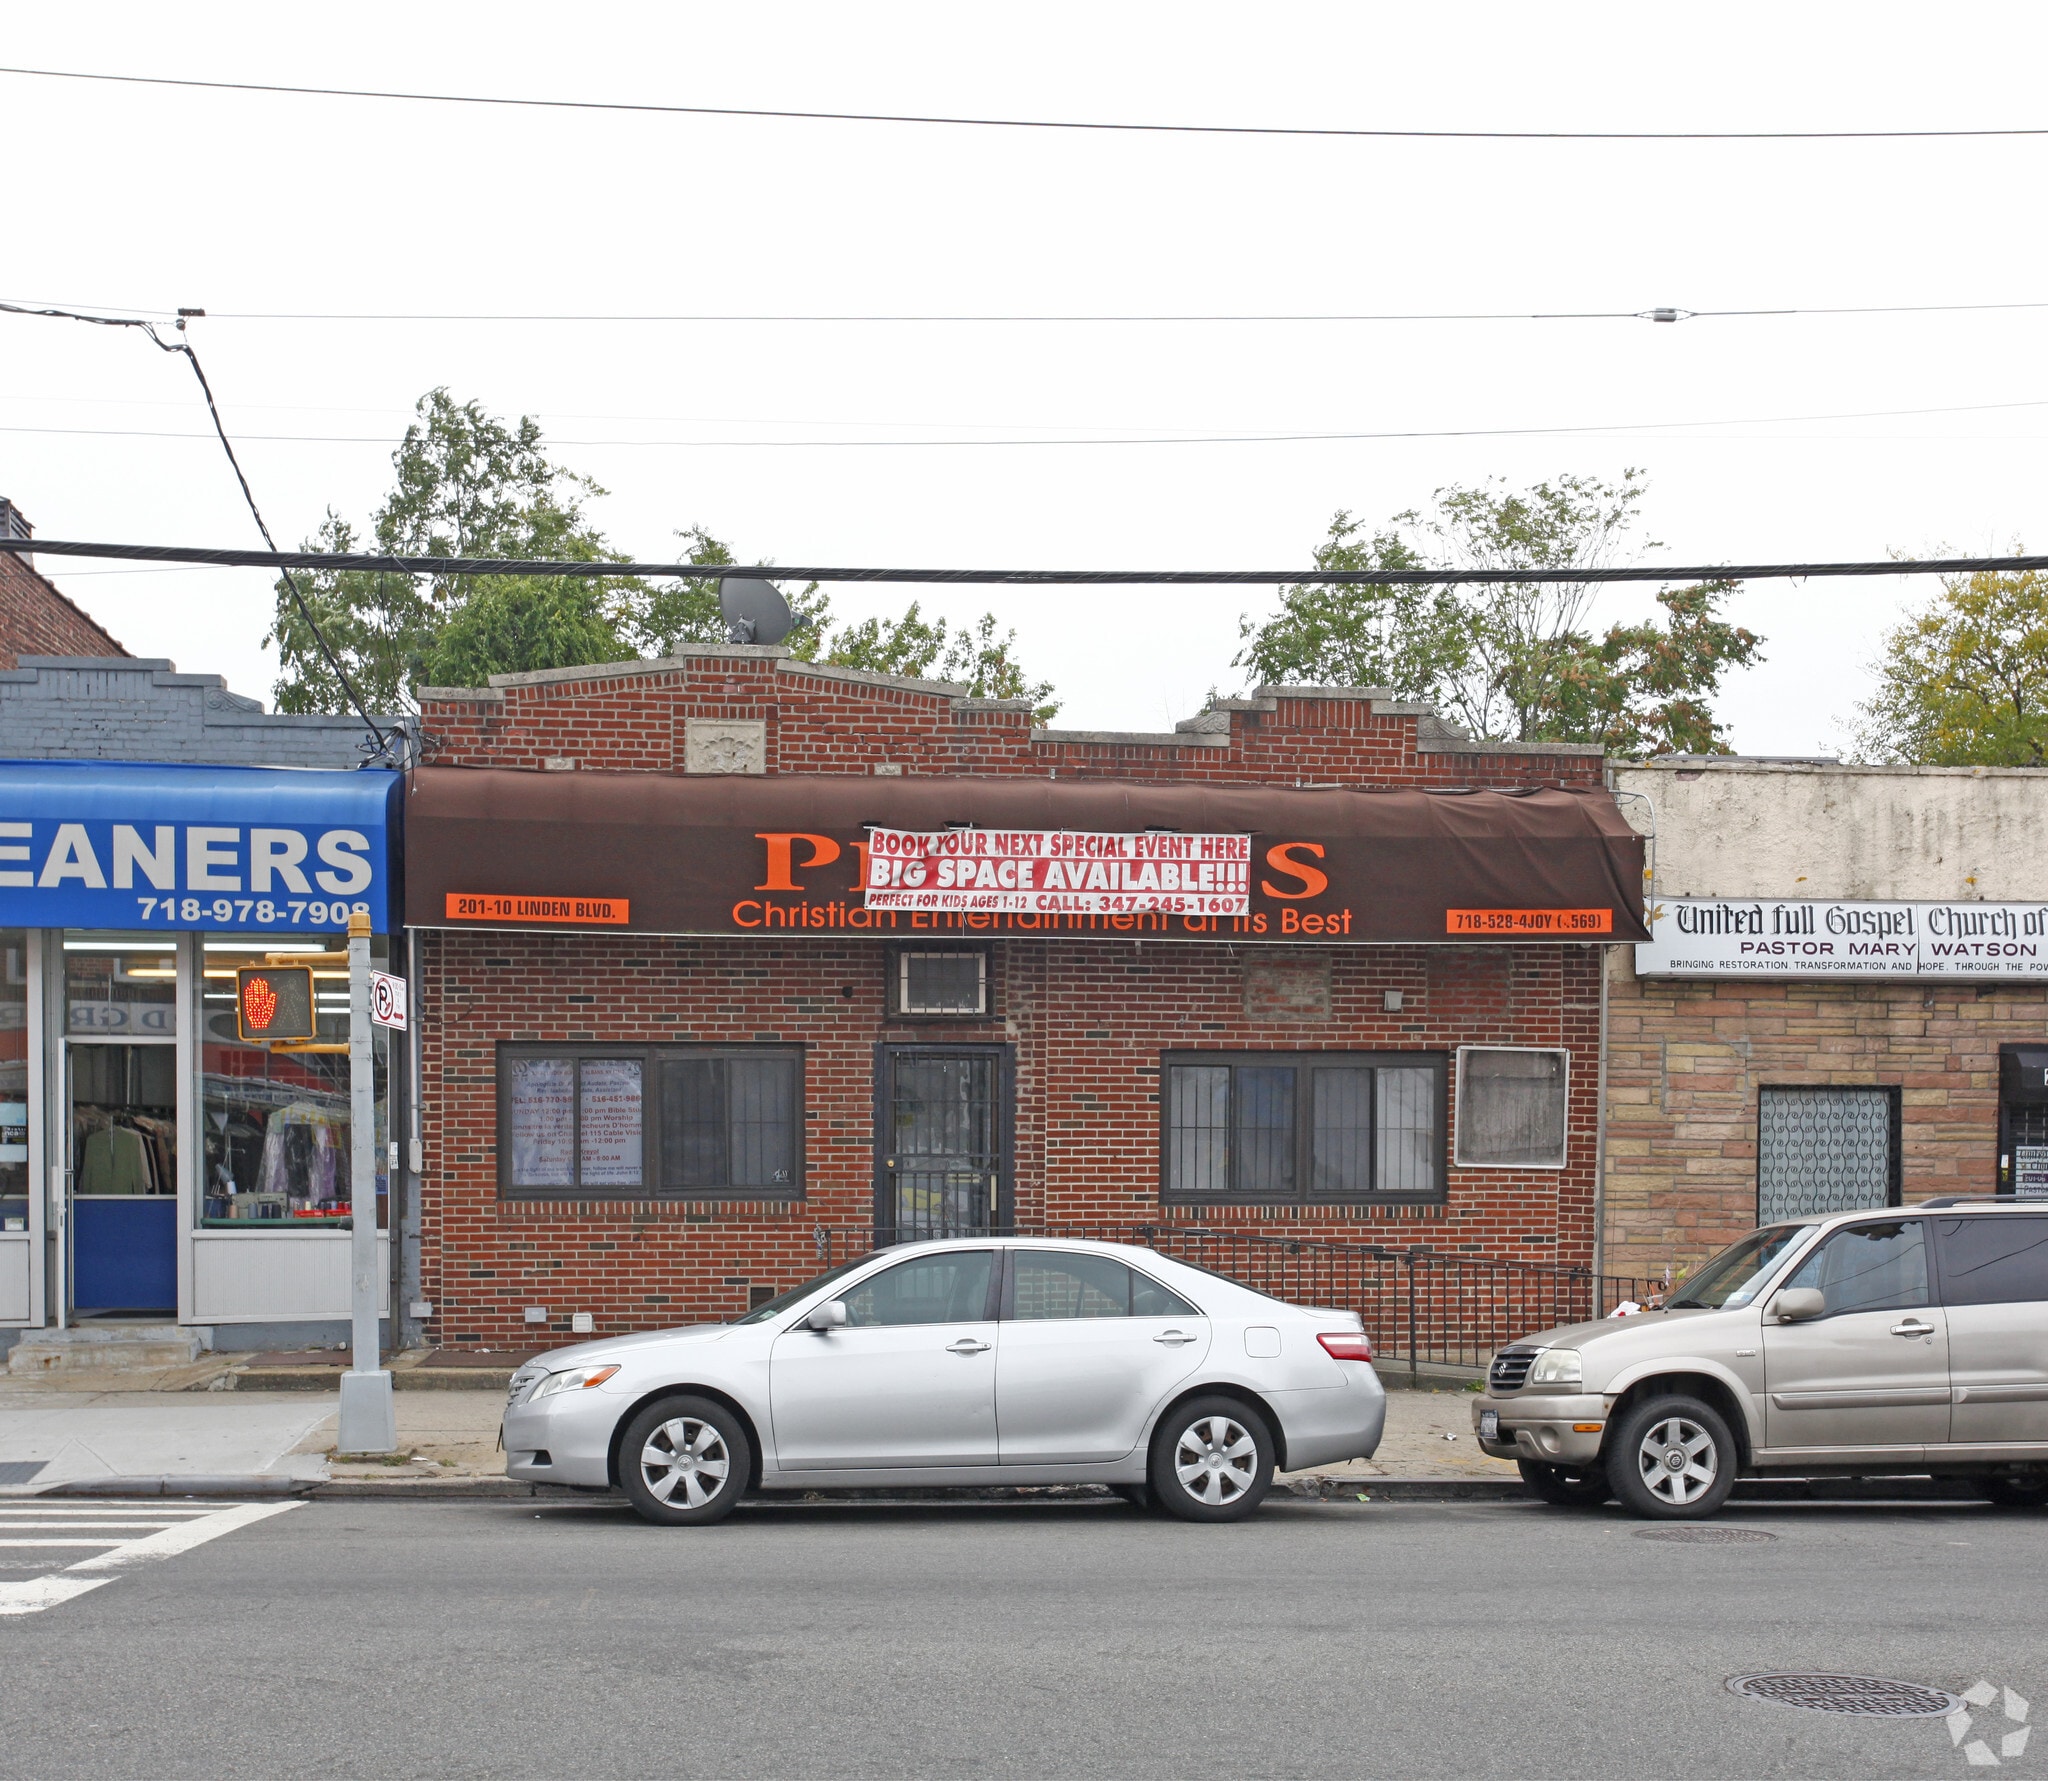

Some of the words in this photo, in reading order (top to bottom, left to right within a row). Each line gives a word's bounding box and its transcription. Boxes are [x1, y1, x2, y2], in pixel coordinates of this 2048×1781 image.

[872, 830, 931, 857] BOOK
[936, 832, 987, 856] YOUR
[995, 833, 1044, 856] NEXT
[1050, 833, 1127, 857] SPECIAL
[1135, 836, 1193, 859] EVENT
[1200, 837, 1248, 859] HERE
[870, 857, 927, 888] BIG
[936, 858, 1034, 889] SPACE
[1042, 860, 1247, 892] AVAILABLE!!!
[458, 898, 512, 915] 201-10
[517, 900, 570, 917] LINDEN
[575, 902, 616, 919] BLVD.
[869, 893, 914, 908] PERFECT
[916, 894, 938, 908] FOR
[941, 894, 968, 908] KIDS
[969, 895, 999, 909] AGES
[1002, 896, 1028, 909] 1-12
[1035, 895, 1091, 912] CALL:
[1098, 895, 1247, 913] 347-245-1607
[732, 900, 897, 928] Christian
[1281, 907, 1353, 935] Best
[1456, 914, 1552, 929] 718-528-4JOY
[1674, 904, 1764, 935] United
[1825, 905, 1916, 941] Gospel
[1928, 906, 2017, 940] Church
[2023, 907, 2048, 936] of
[1740, 941, 1835, 955] PASTOR
[1849, 943, 1917, 955] MARY
[1931, 943, 2037, 957] WATSON
[1670, 960, 1714, 969] BRINGING
[1795, 961, 1886, 971] TRANSFORMATION
[1891, 962, 1912, 970] AND
[1955, 962, 1999, 971] THROUGH
[2006, 963, 2023, 971] THE
